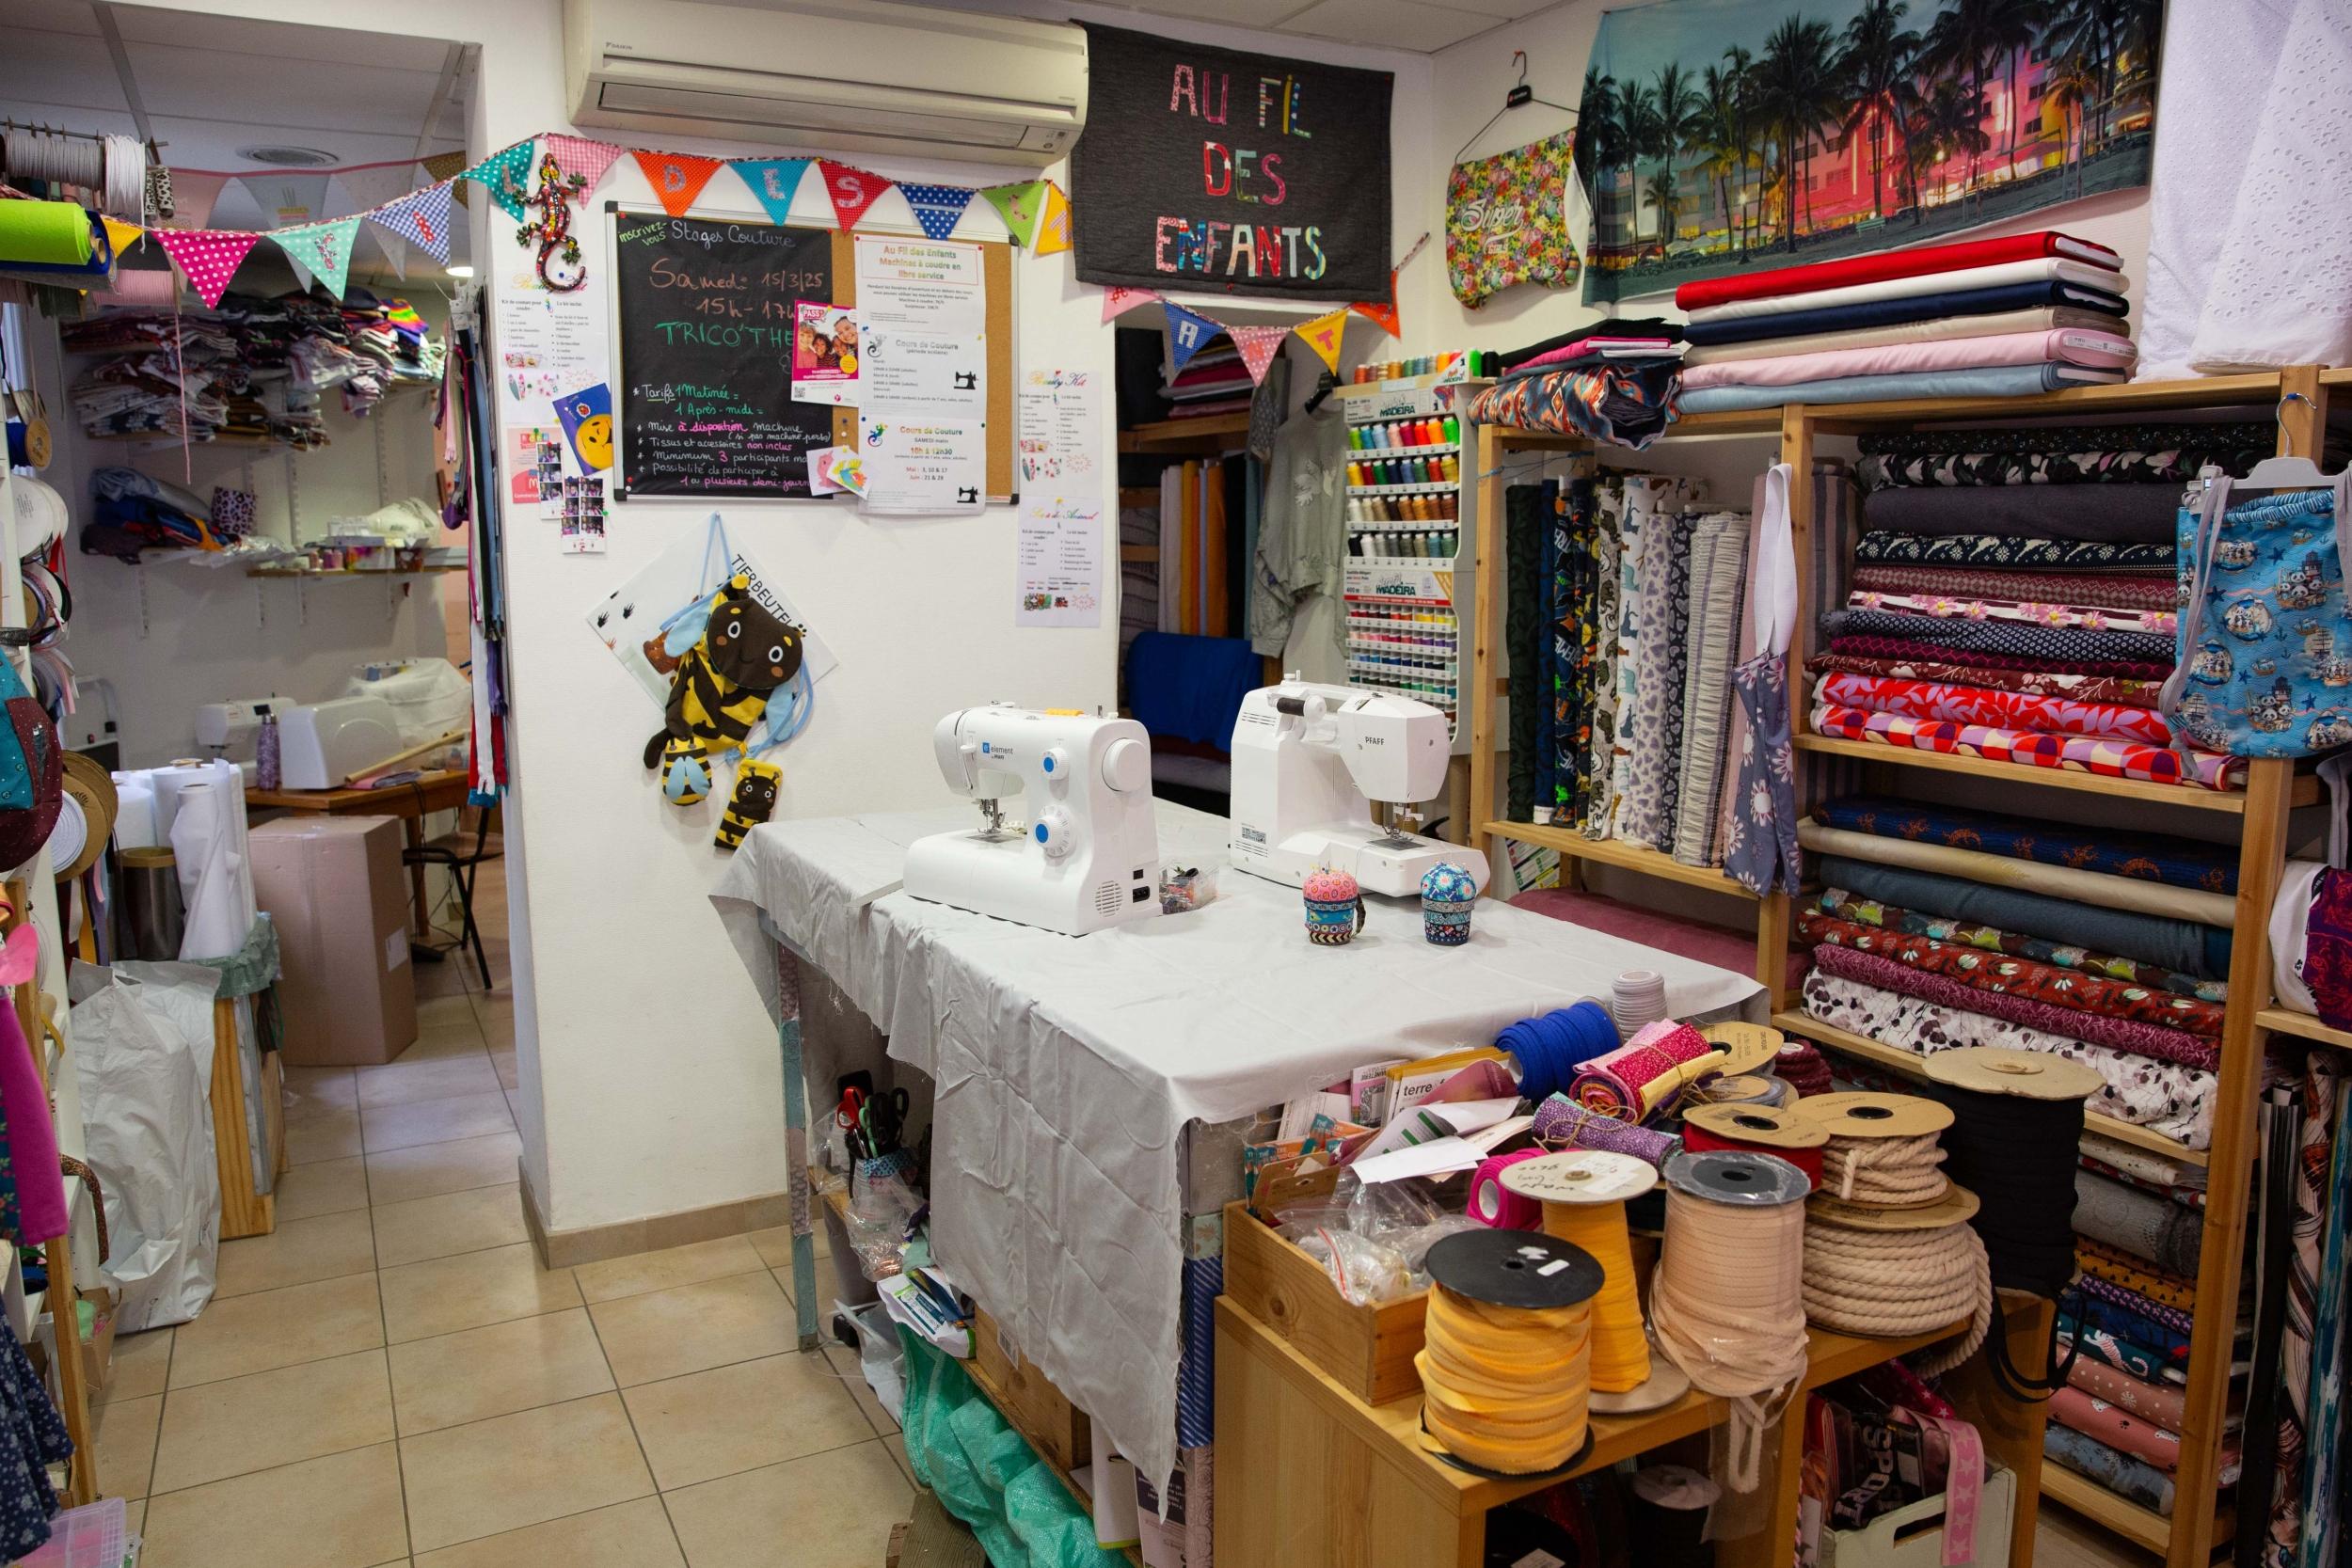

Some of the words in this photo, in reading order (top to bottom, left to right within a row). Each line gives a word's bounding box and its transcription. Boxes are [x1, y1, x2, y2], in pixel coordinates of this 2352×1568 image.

[1170, 64, 1229, 125] AU
[1259, 74, 1312, 139] FIL
[1204, 141, 1287, 206] DES
[1460, 198, 1525, 231] Super
[672, 220, 723, 249] Stages
[728, 226, 797, 247] Couture
[883, 245, 896, 255] Au
[927, 248, 957, 260] Enfants
[1155, 215, 1327, 280] ENFANTS
[925, 261, 950, 270] coudre
[761, 269, 824, 292] 15/3/25
[917, 271, 945, 280] service
[930, 341, 959, 350] Couture
[642, 384, 675, 404] Tarifs
[684, 383, 730, 400] Matinée
[1379, 404, 1416, 418] MADEIRA
[754, 420, 803, 434] machine
[900, 425, 922, 435] Cours
[650, 437, 682, 449] Tissus
[719, 451, 729, 463] 3
[733, 452, 790, 467] participants
[1375, 584, 1416, 595] MADEIRA
[1364, 736, 1385, 746] PFAFF
[991, 744, 1013, 754] element
[1404, 1083, 1432, 1097] terre
